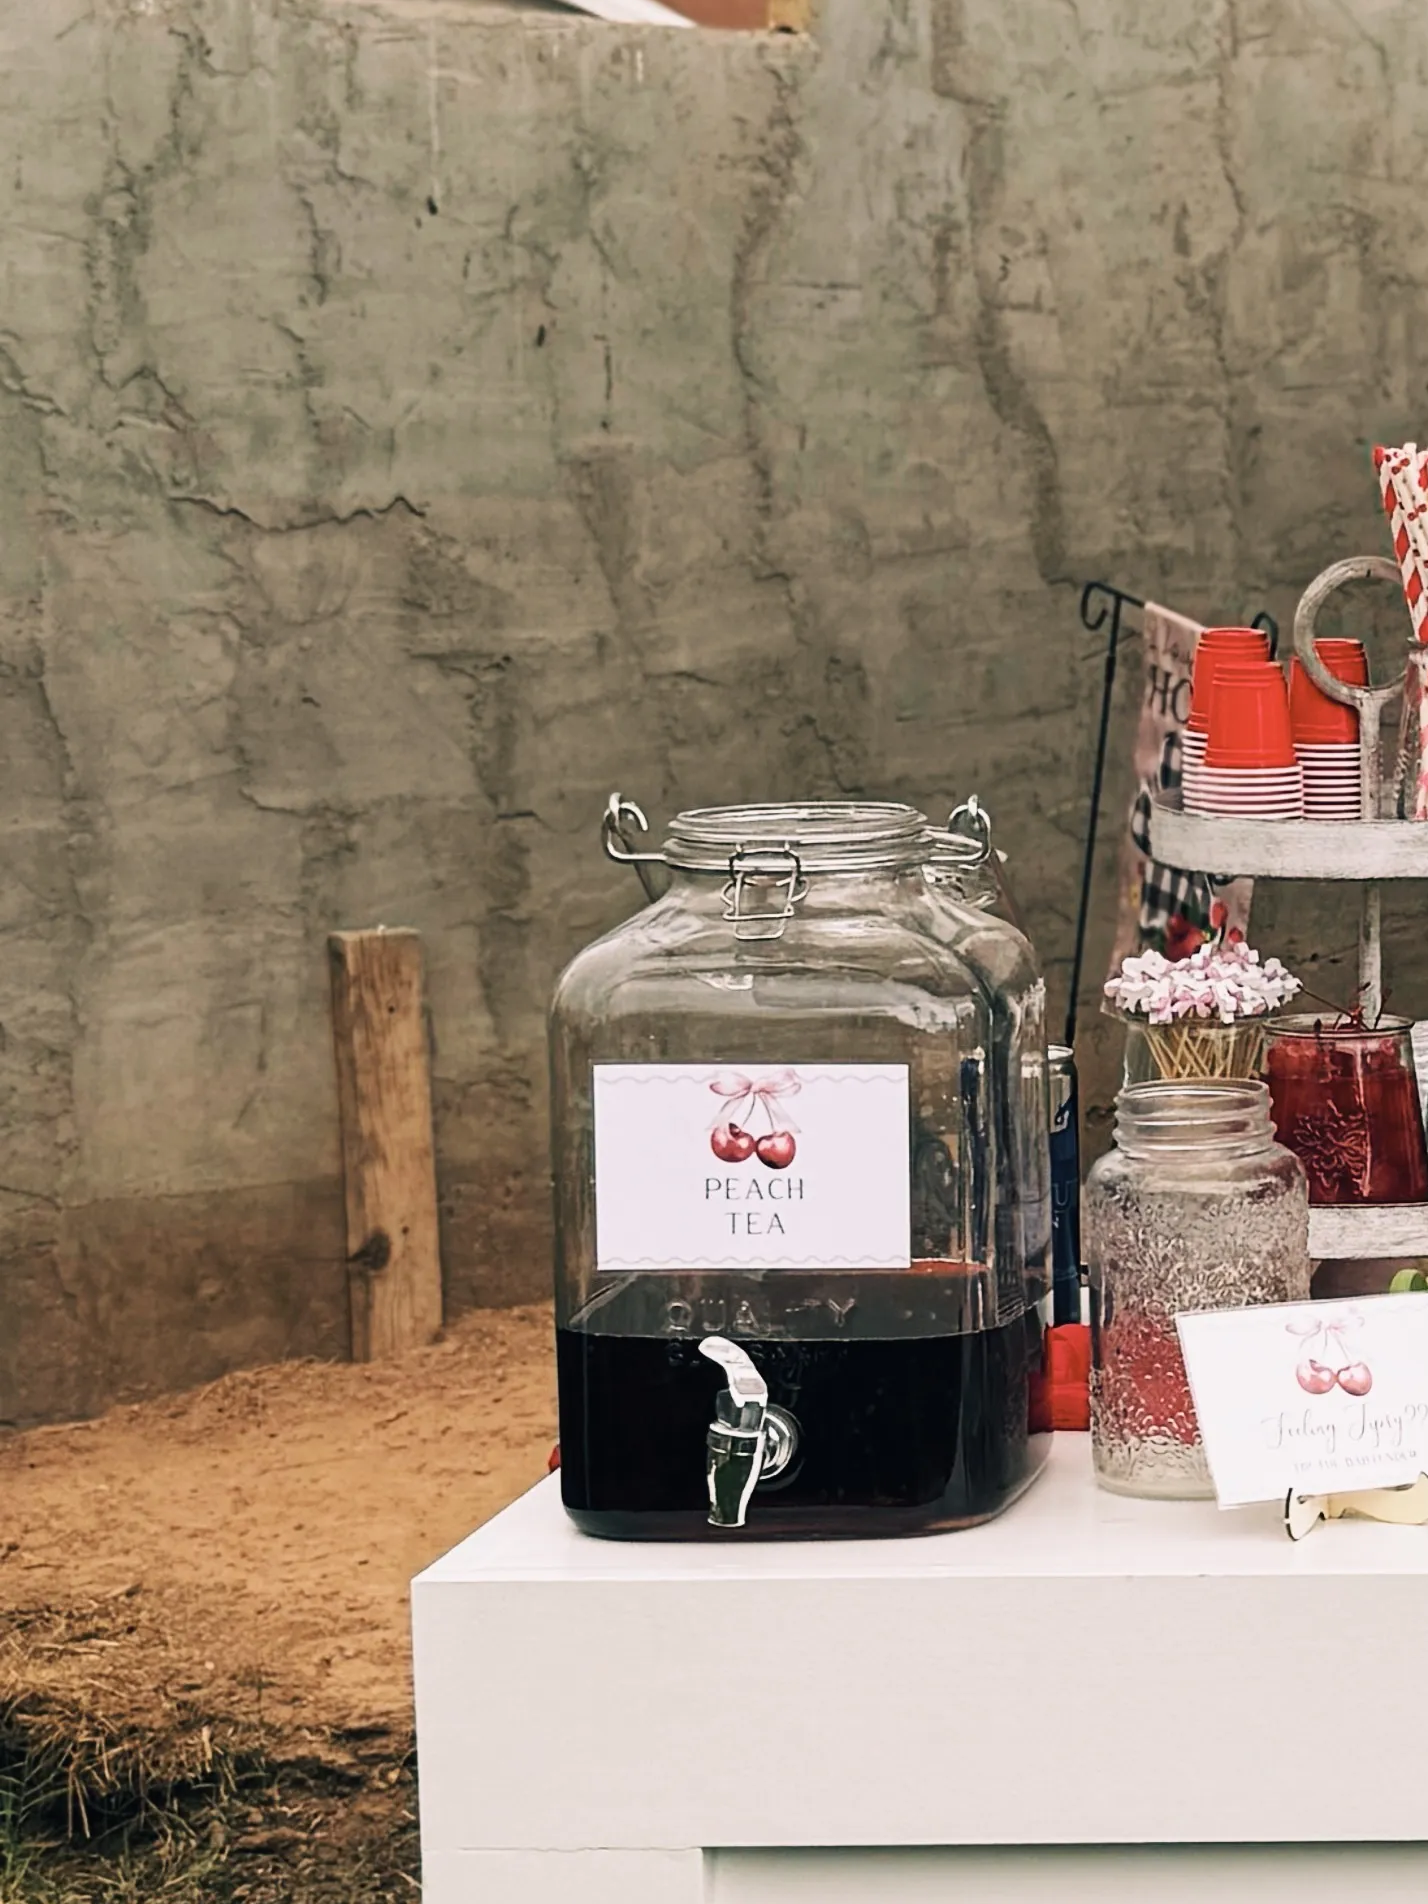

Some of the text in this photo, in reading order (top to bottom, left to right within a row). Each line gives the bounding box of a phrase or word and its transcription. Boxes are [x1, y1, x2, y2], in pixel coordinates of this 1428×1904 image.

[704, 1177, 805, 1201] PEACH
[725, 1212, 787, 1236] TEA
[1259, 1407, 1337, 1454] Feeling
